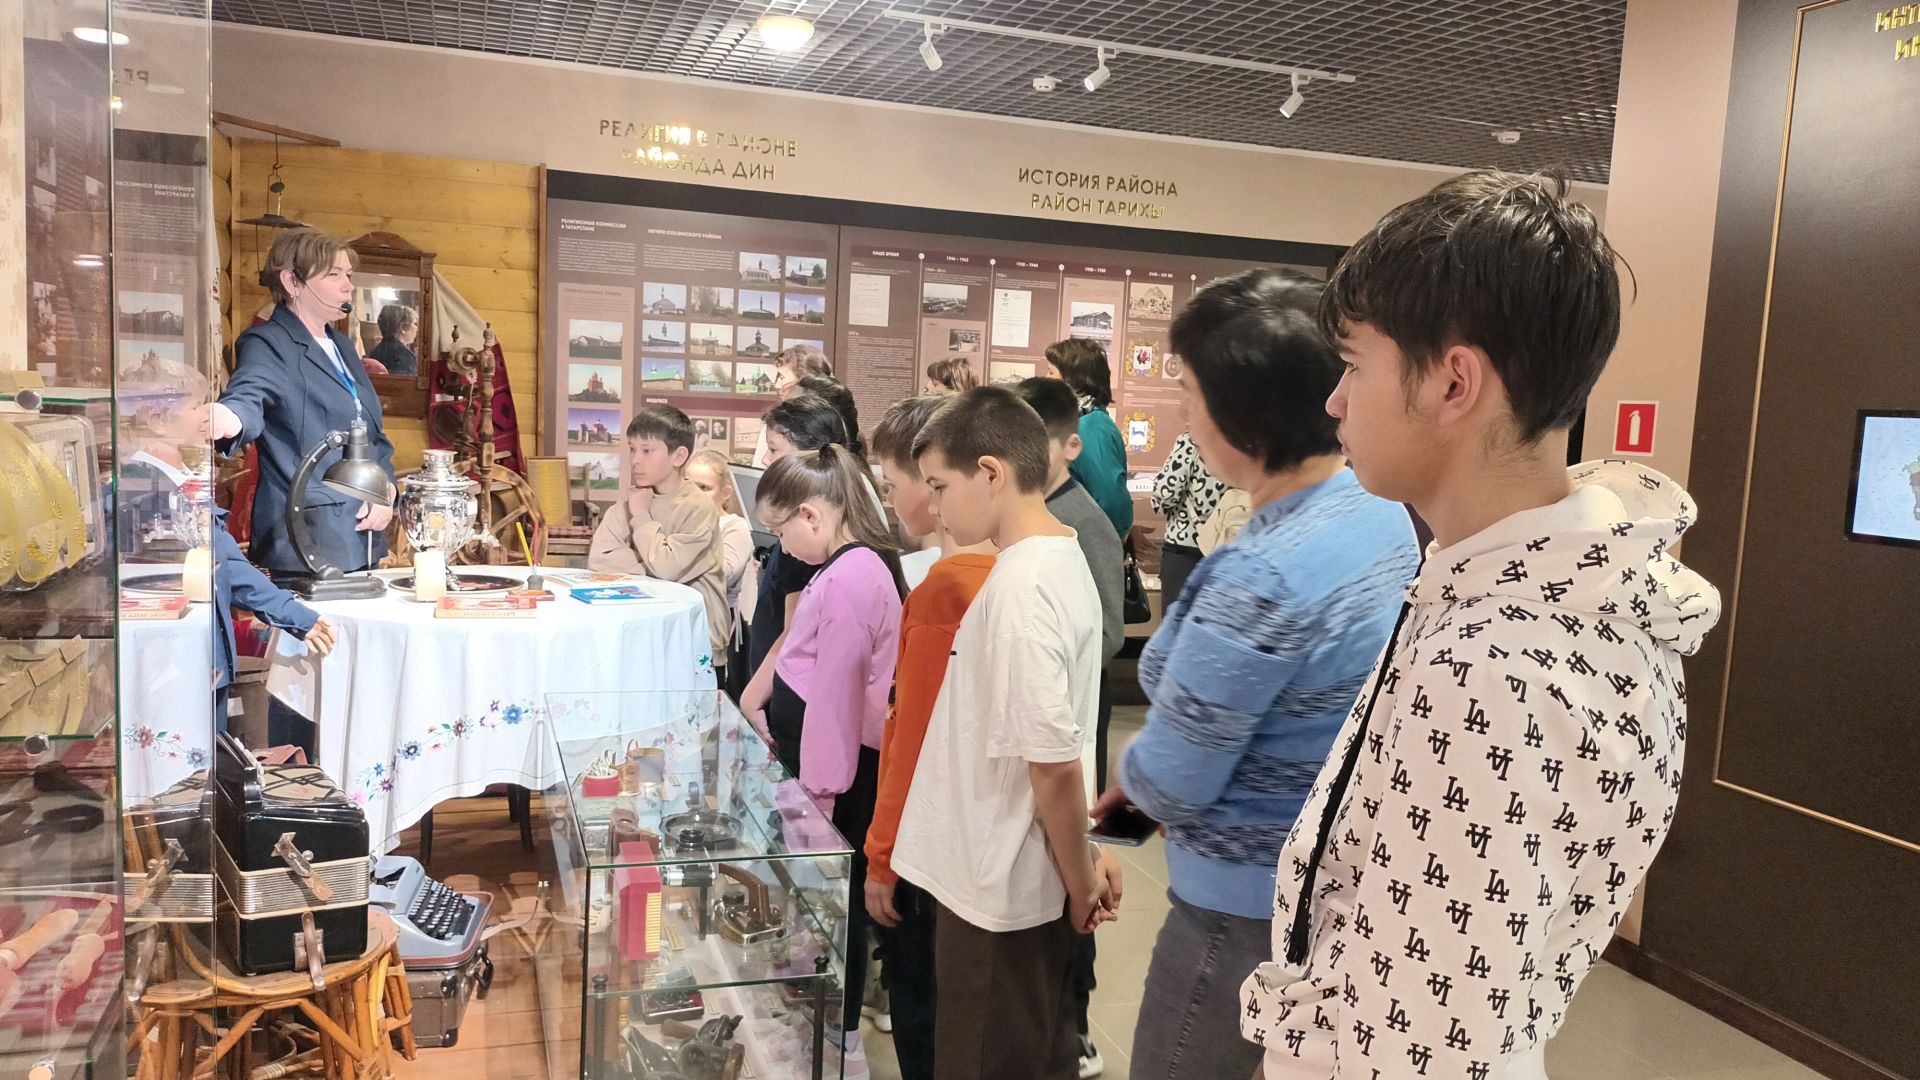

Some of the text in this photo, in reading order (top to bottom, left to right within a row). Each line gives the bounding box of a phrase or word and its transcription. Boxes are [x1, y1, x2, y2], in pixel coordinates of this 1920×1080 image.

[1875, 3, 1920, 33] ИНТ
[732, 161, 776, 181] ДИН
[1018, 167, 1179, 198] ИСТОРИЯ РАЙОНА
[1031, 193, 1165, 220] РАЙОН ТАРИХЫ
[1496, 560, 1528, 585] LA
[1577, 544, 1609, 570] LA
[1540, 578, 1573, 602] LA
[1459, 618, 1491, 639] LA
[1550, 613, 1584, 637] LA
[1593, 619, 1624, 644] LA
[1521, 649, 1558, 670] LA
[1566, 650, 1597, 677] LA
[1605, 671, 1638, 698] LA
[1411, 685, 1432, 719] LA
[1463, 698, 1490, 735] LA
[1428, 729, 1451, 765] LA
[1524, 713, 1543, 748] LA
[1391, 759, 1412, 794] LA
[1486, 745, 1513, 781] LA
[1541, 758, 1563, 792] LA
[1443, 776, 1469, 812] LA
[1597, 770, 1621, 803] LA
[1407, 805, 1431, 841] LA
[1504, 792, 1526, 824] LA
[1552, 802, 1578, 833] LA
[1371, 832, 1391, 868] LA
[1465, 823, 1492, 858] LA
[1524, 834, 1541, 866] LA
[1564, 841, 1589, 869] LA
[1423, 852, 1449, 888] LA
[1484, 869, 1509, 903] LA
[1387, 879, 1412, 915] LA
[1537, 874, 1552, 906] LA
[1354, 903, 1373, 940] LA
[1445, 899, 1472, 935] LA
[1506, 913, 1528, 945] LA
[1404, 927, 1430, 962] LA
[1371, 951, 1393, 987] LA
[1465, 945, 1491, 979] LA
[1427, 973, 1453, 1007] LA
[1487, 988, 1510, 1019] LA
[1386, 998, 1411, 1033] LA
[1285, 1029, 1306, 1057] LA
[1353, 1020, 1375, 1056] LA
[1445, 1017, 1471, 1051] LA
[1407, 1043, 1432, 1075] LA
